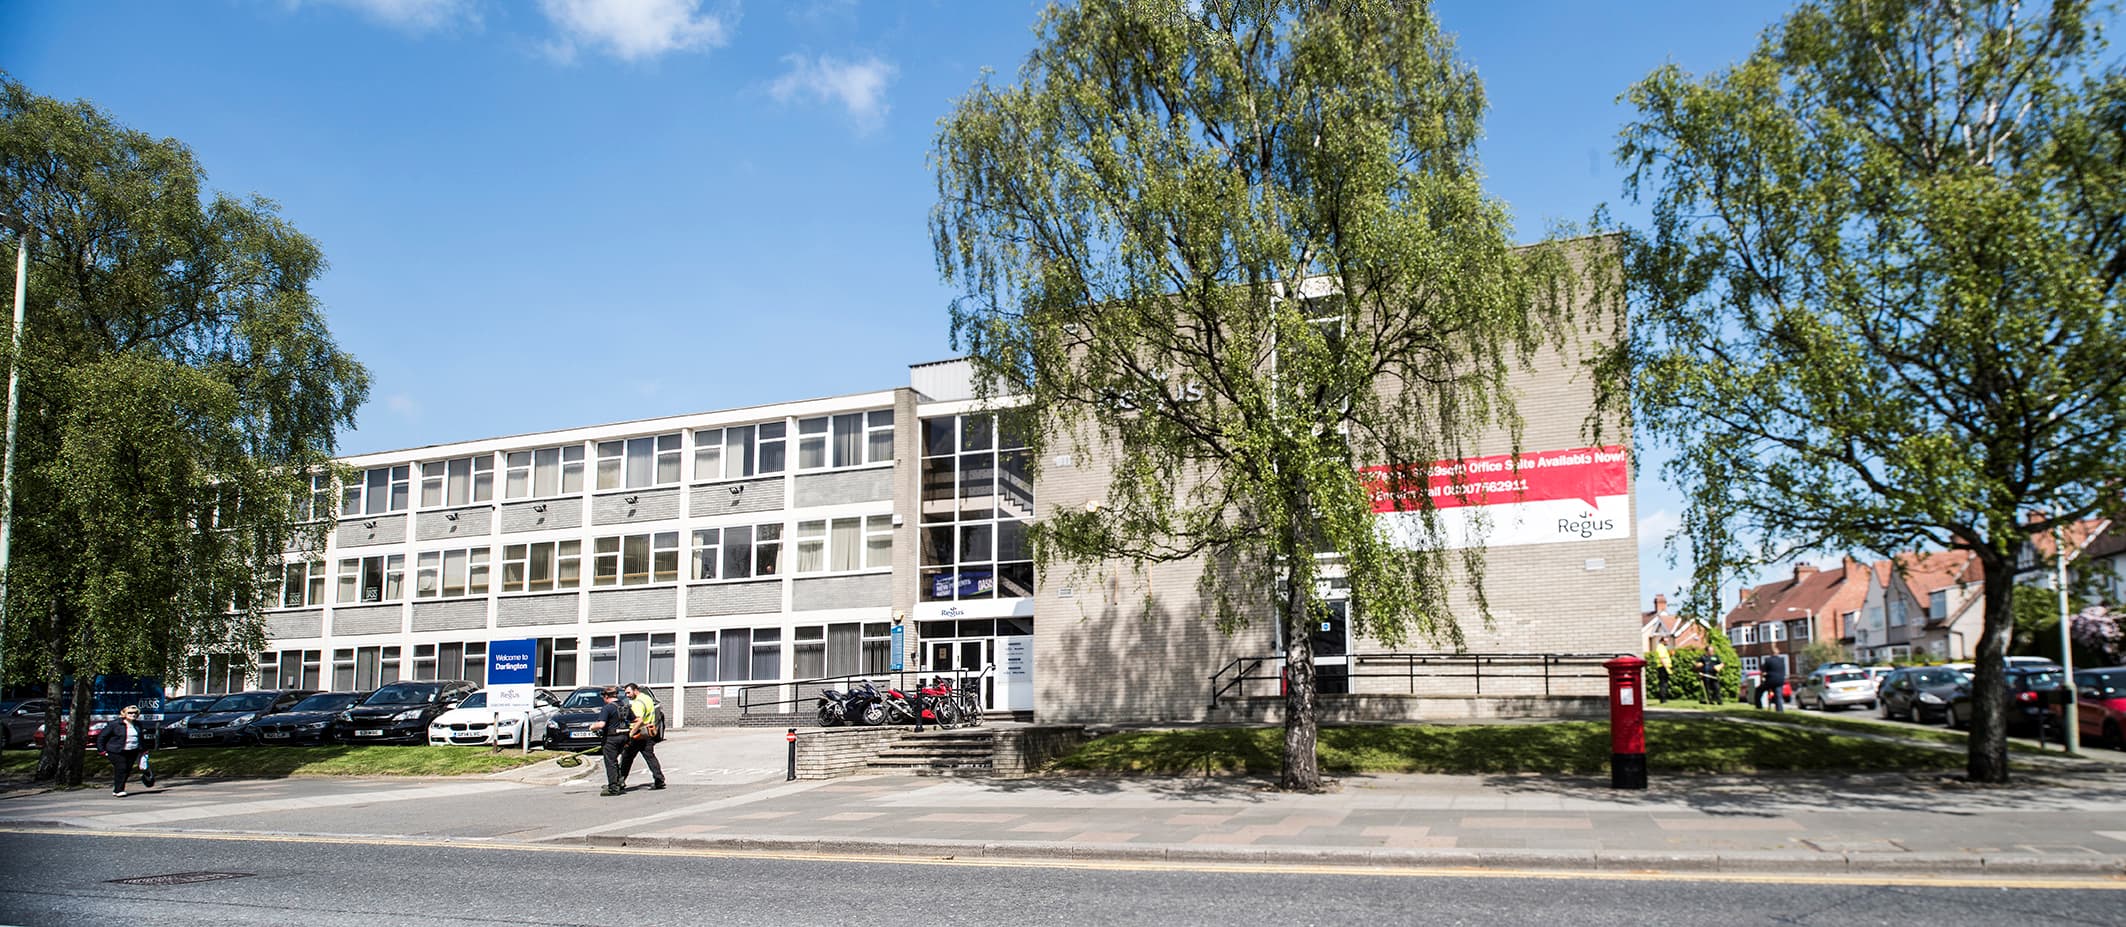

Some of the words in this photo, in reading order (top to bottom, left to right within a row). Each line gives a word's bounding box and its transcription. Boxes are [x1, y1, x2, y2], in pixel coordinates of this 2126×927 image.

[1469, 461, 1502, 474] Office
[1538, 454, 1591, 467] Available
[1594, 450, 1625, 463] Now!
[1421, 486, 1441, 498] all
[1558, 518, 1614, 538] Regus
[941, 609, 964, 617] Regus
[495, 654, 521, 662] Welcome
[495, 662, 528, 671] Darlington
[500, 690, 520, 699] Regus
[138, 698, 160, 709] OASIS
